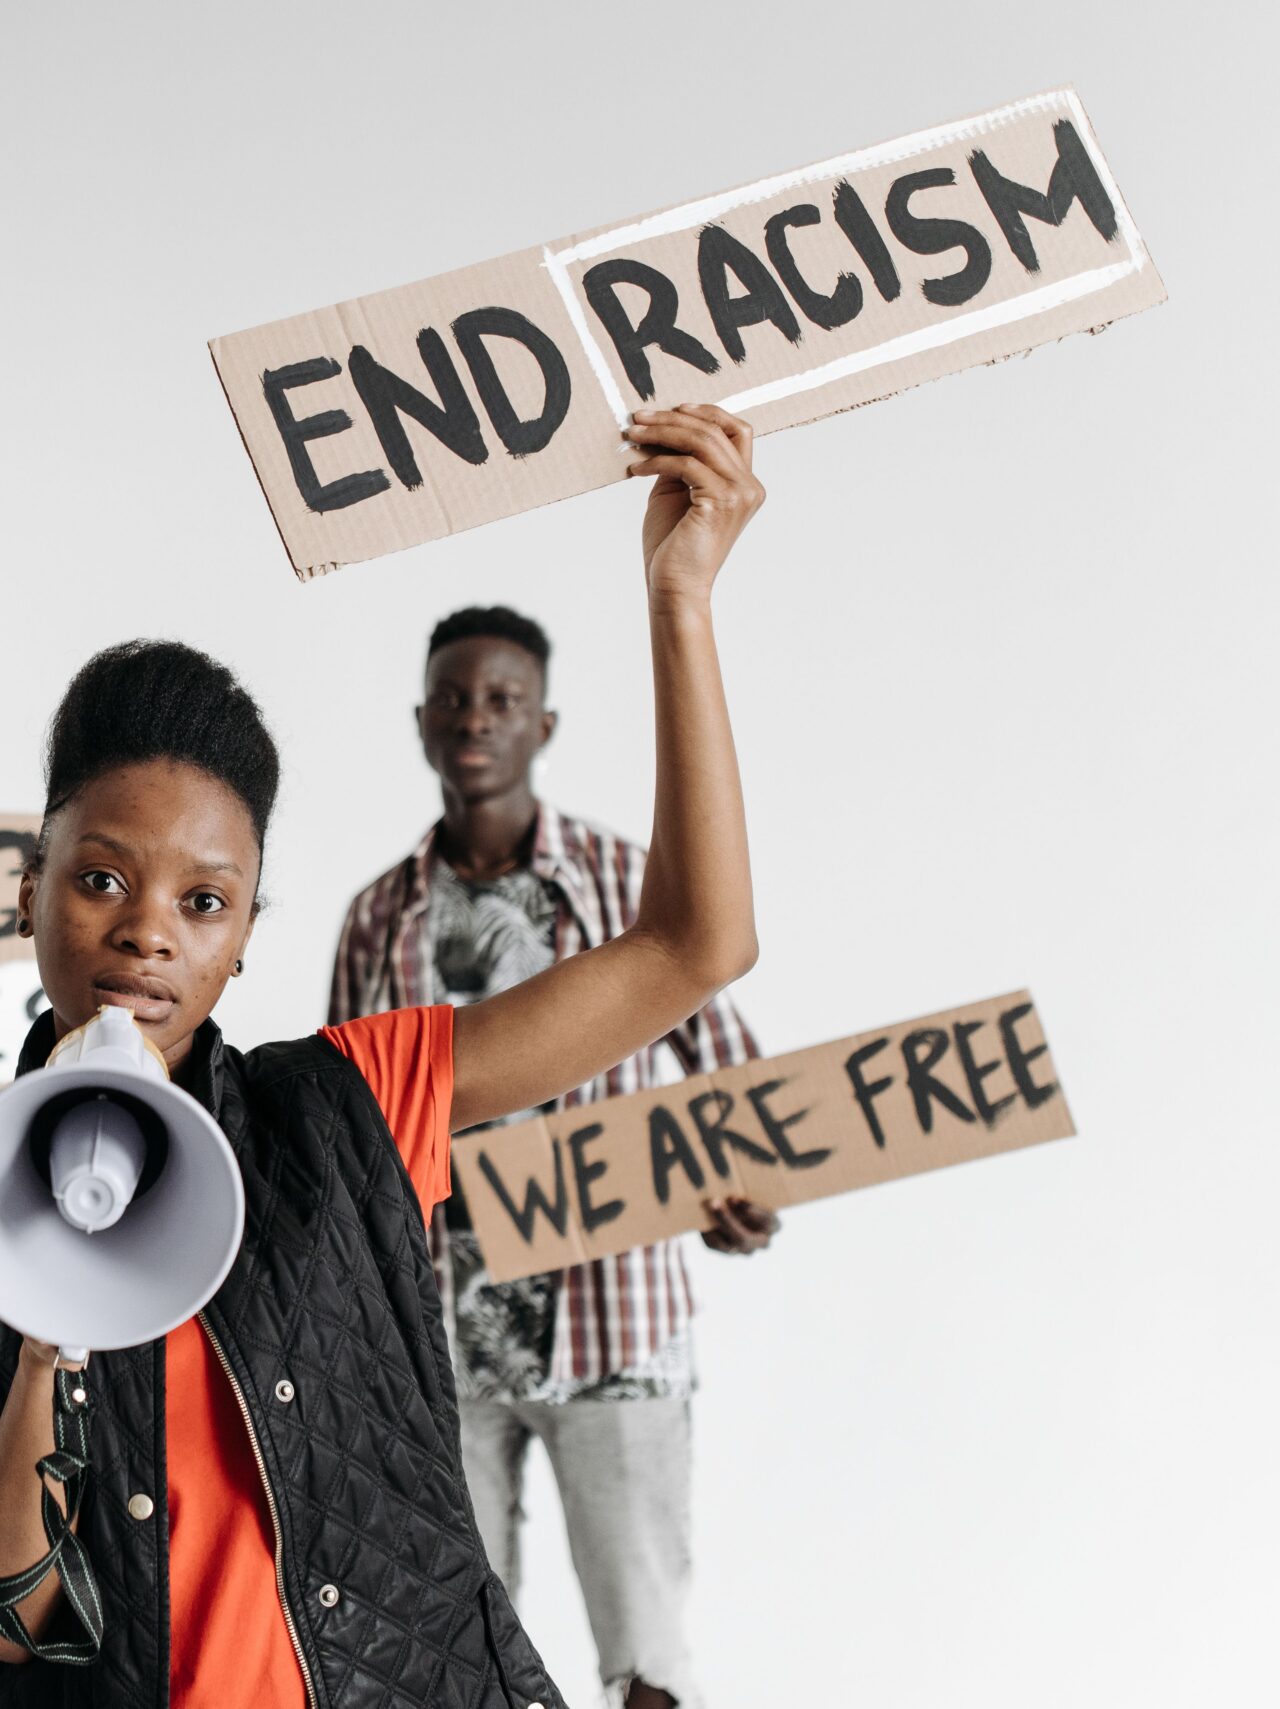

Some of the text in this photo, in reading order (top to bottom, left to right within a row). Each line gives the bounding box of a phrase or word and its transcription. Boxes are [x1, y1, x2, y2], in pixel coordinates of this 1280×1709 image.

[263, 116, 1124, 516] END RACISM
[477, 1001, 1062, 1247] WE ARE FREE
